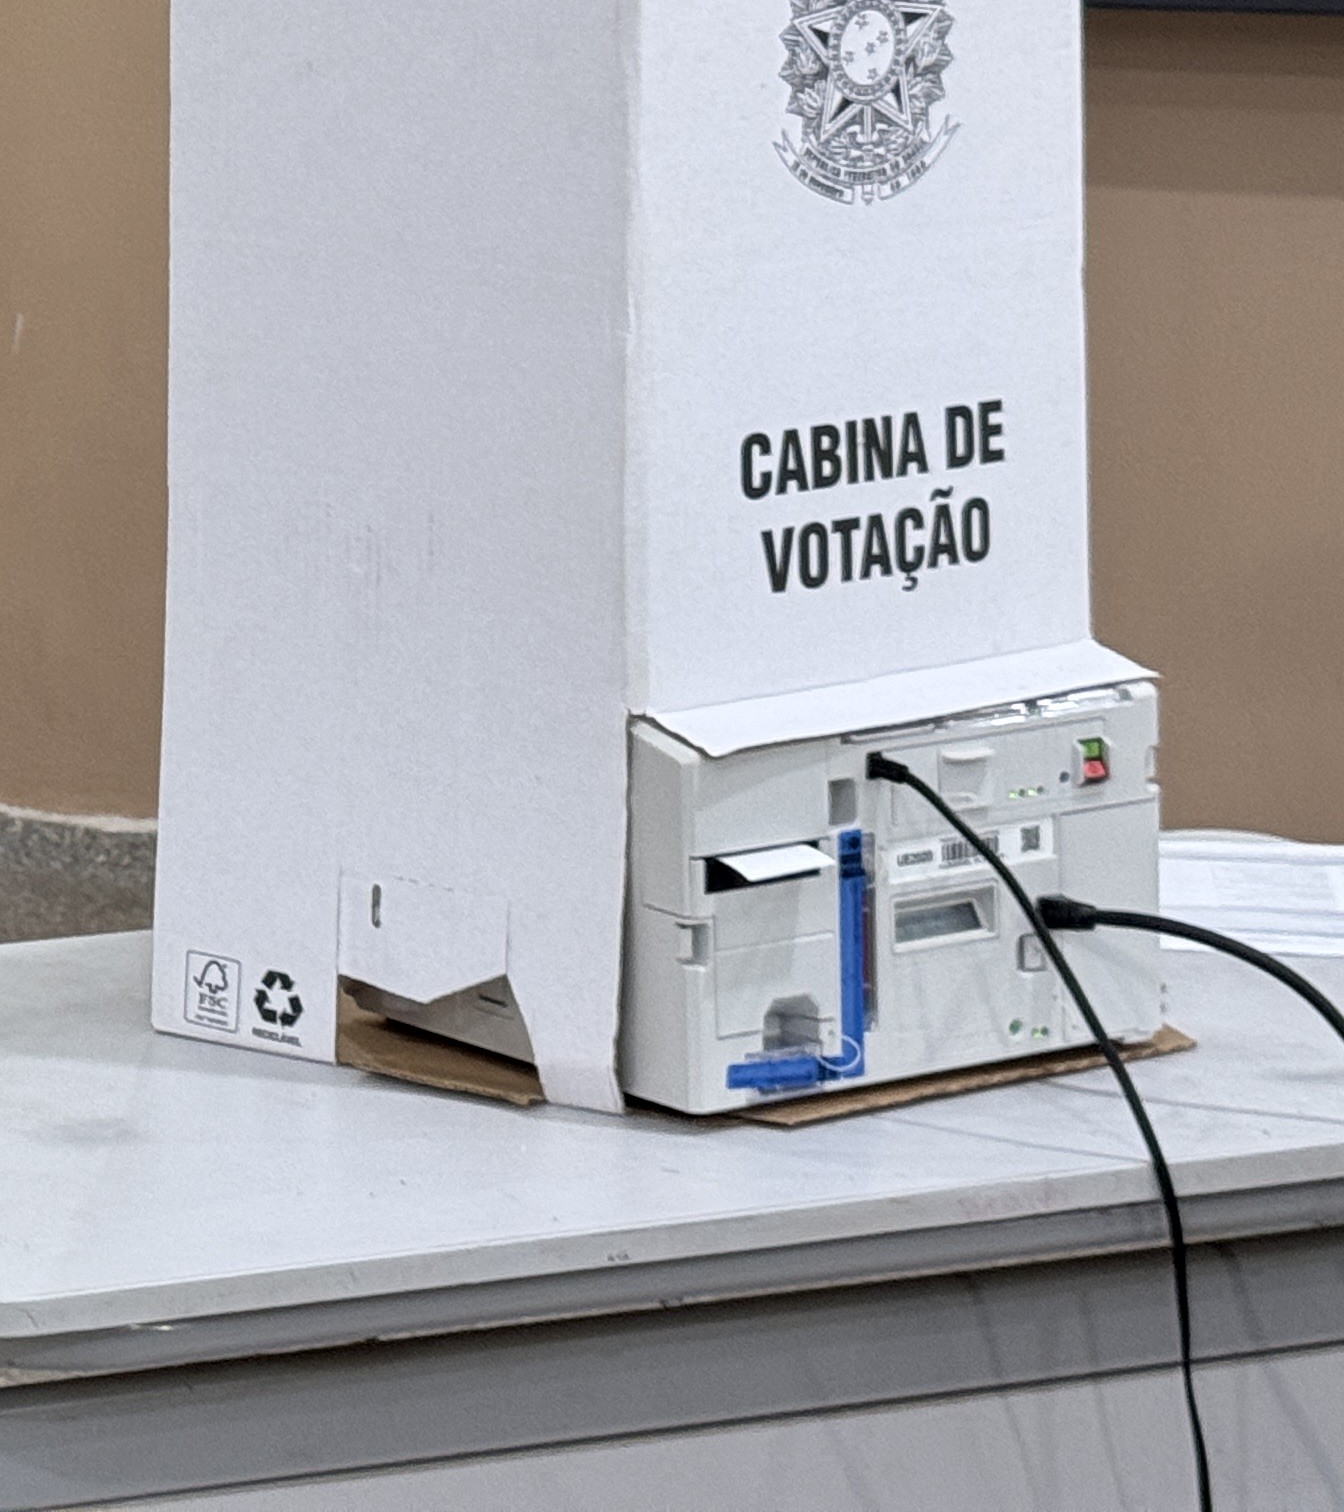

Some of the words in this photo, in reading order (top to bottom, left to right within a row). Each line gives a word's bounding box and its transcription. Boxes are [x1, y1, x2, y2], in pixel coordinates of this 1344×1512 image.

[740, 410, 929, 500] CABINA
[944, 399, 1005, 470] DE
[761, 486, 991, 593] VOTAÇÃO
